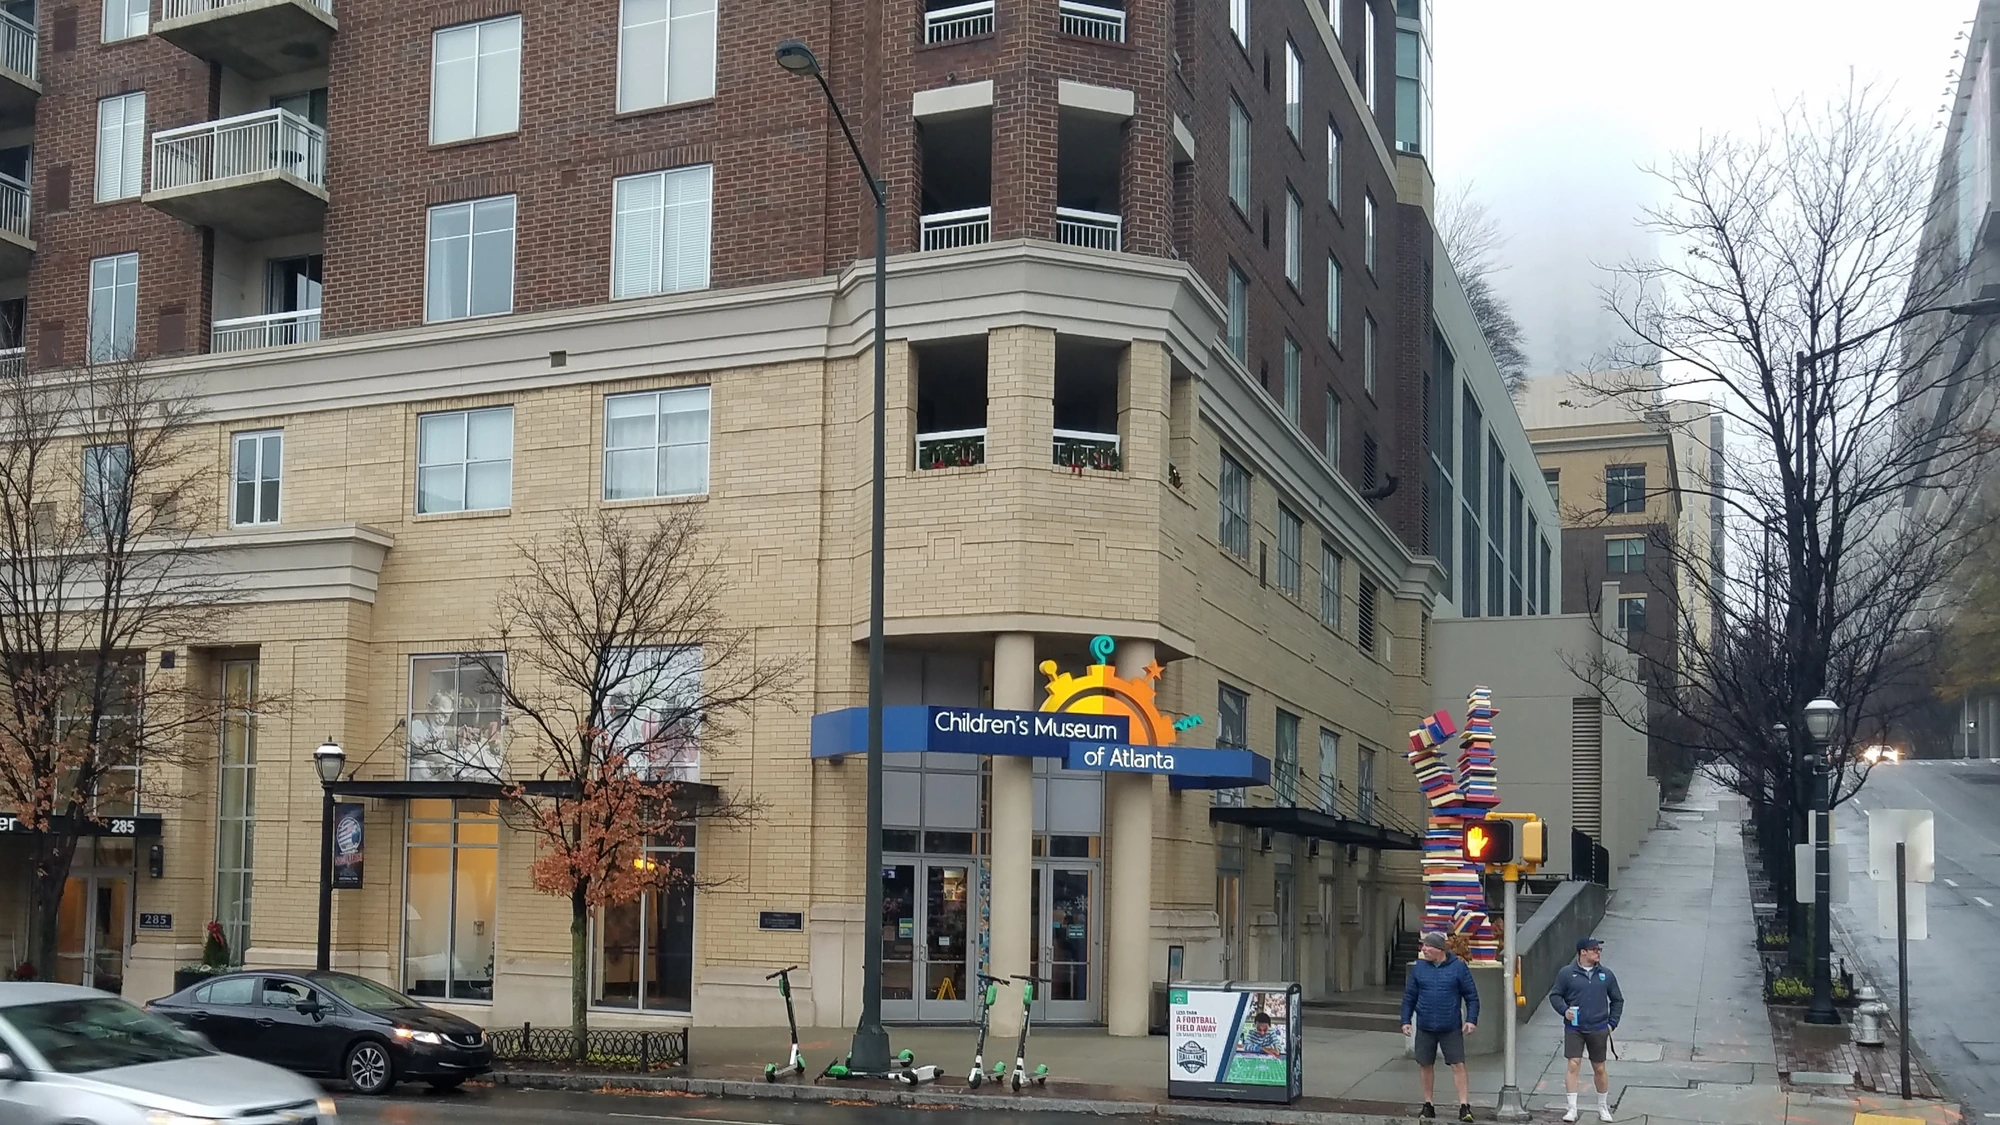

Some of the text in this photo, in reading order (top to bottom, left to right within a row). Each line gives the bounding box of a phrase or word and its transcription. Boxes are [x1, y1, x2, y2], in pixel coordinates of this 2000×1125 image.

[935, 711, 1117, 740] Children's Museum
[1084, 747, 1175, 770] of Atlanta
[111, 820, 135, 833] 285
[144, 914, 167, 925] 285
[1182, 1016, 1217, 1024] FOOTBALL
